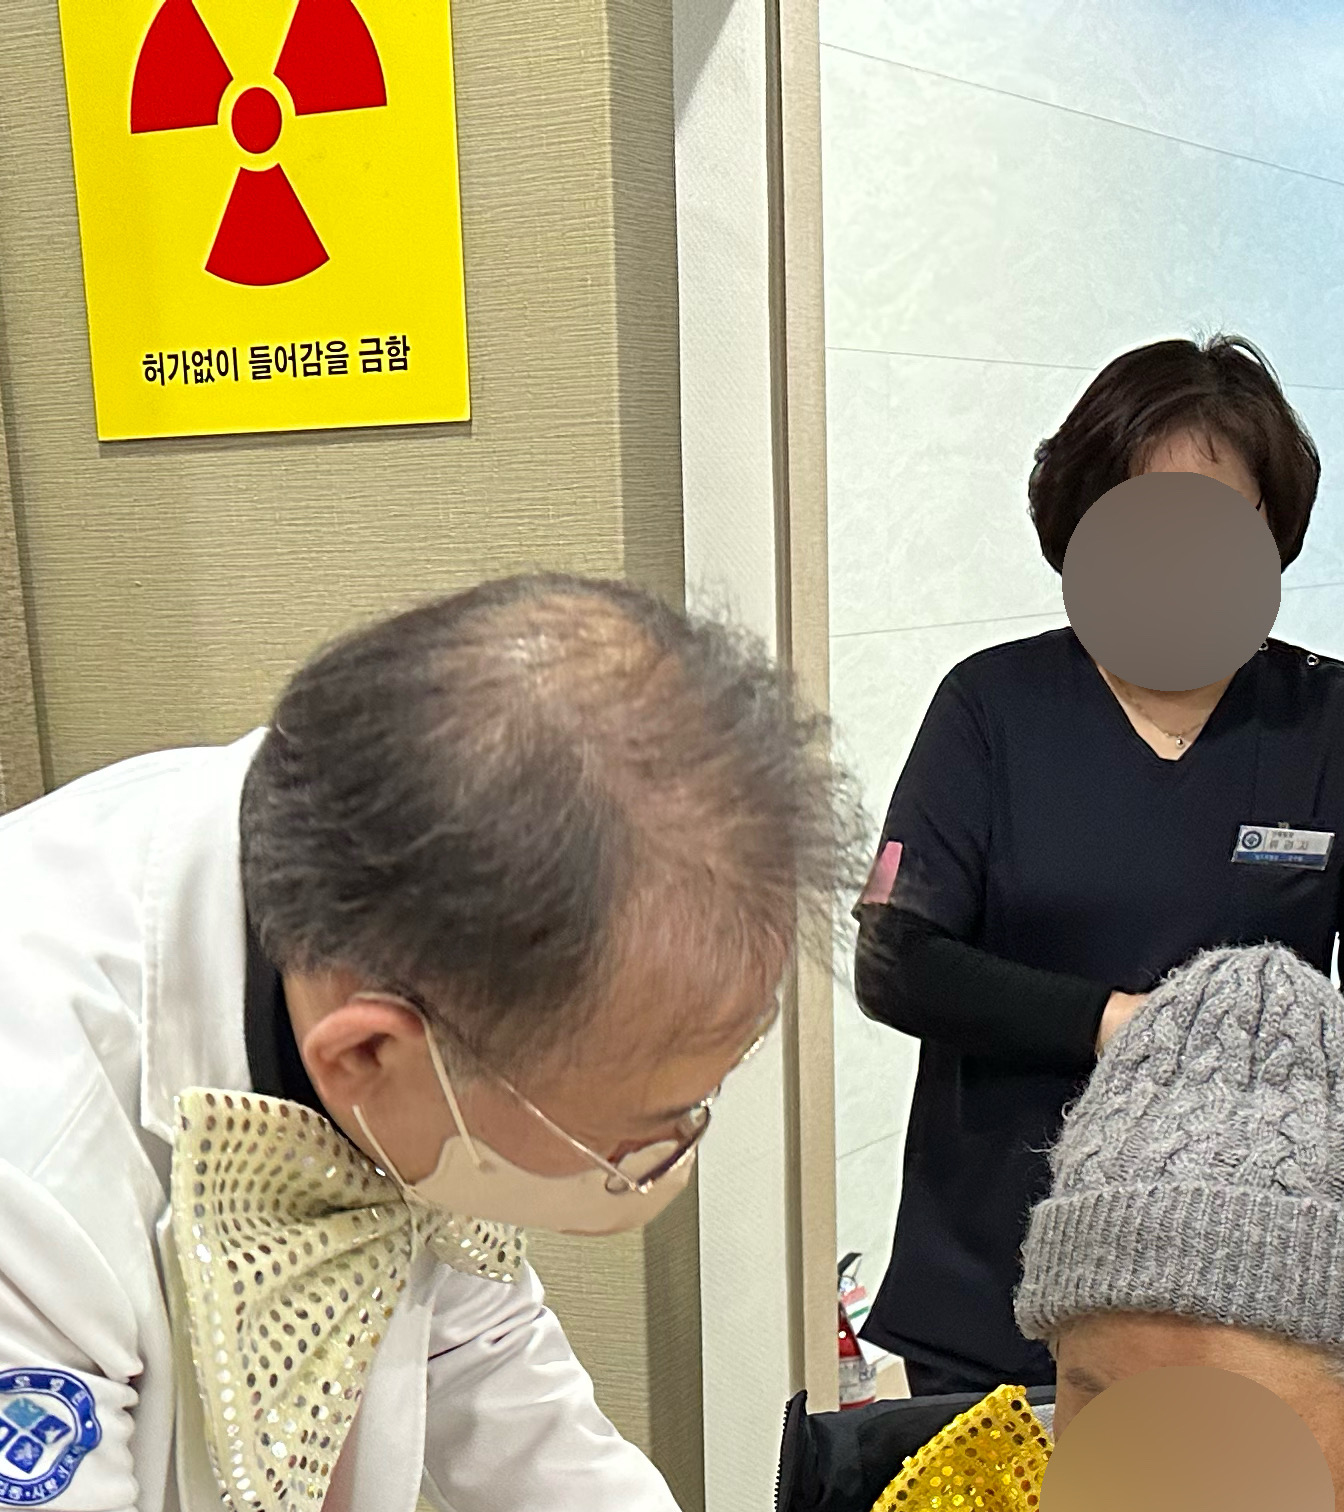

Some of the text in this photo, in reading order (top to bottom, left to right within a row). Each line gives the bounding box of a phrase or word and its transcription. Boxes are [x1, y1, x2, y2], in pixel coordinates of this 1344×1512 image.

[142, 335, 411, 386] 허가없이 들어감을 금함
